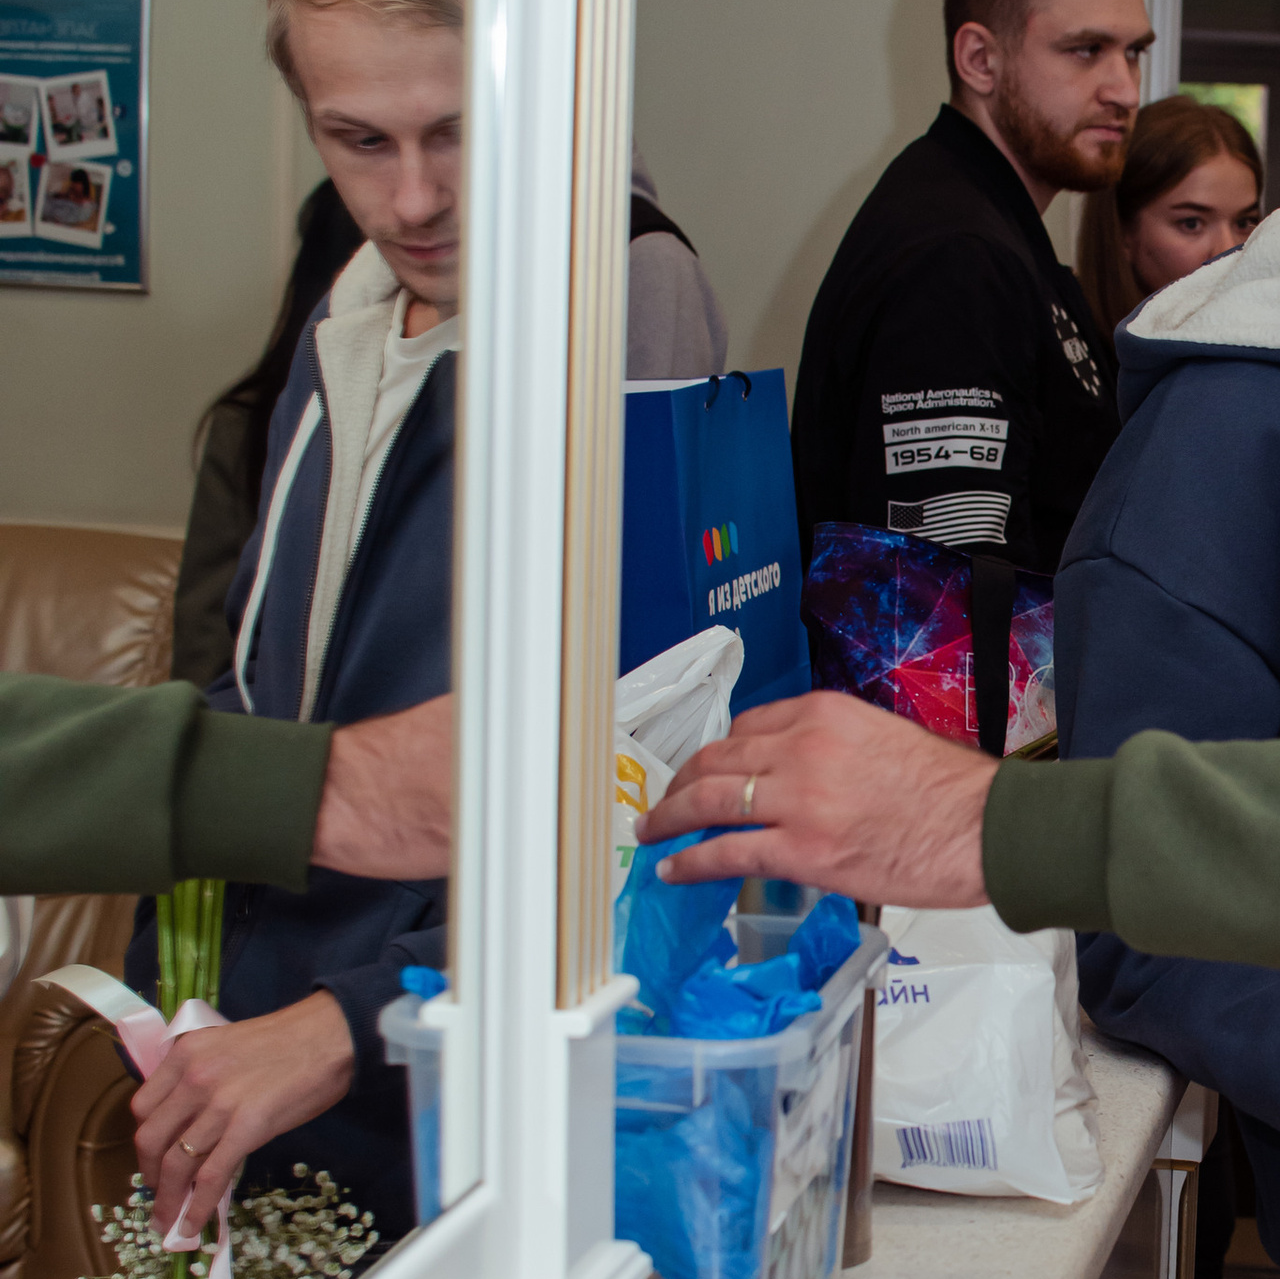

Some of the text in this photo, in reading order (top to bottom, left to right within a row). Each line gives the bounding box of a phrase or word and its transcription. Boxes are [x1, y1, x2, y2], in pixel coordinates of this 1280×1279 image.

[881, 391, 925, 403] National
[926, 387, 991, 399] Aeronautics
[882, 398, 996, 415] Space Administration.
[892, 422, 1000, 438] North american X-15
[717, 582, 731, 613] из
[732, 561, 781, 611] детского
